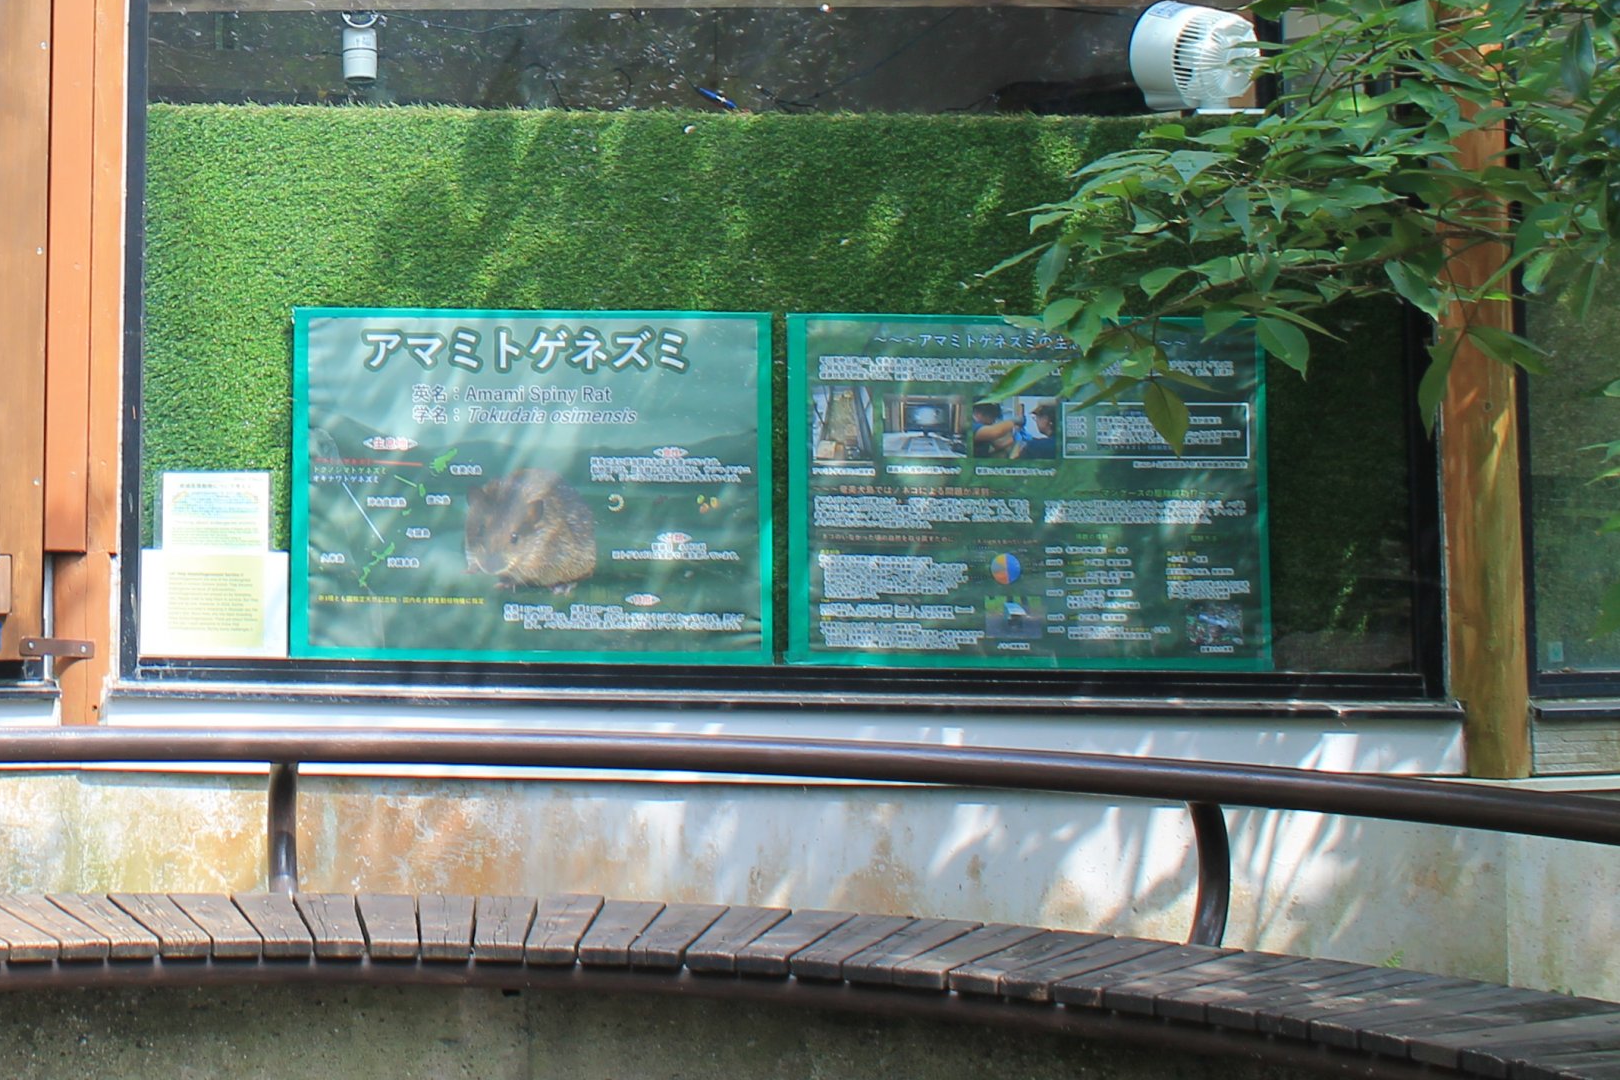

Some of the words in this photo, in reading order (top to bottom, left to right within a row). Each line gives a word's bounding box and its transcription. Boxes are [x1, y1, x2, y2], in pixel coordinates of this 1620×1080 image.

[363, 326, 687, 372] アマミトゲネズミ
[530, 386, 576, 404] Spiny
[582, 386, 612, 402] Rat
[550, 408, 637, 424] osimensis
